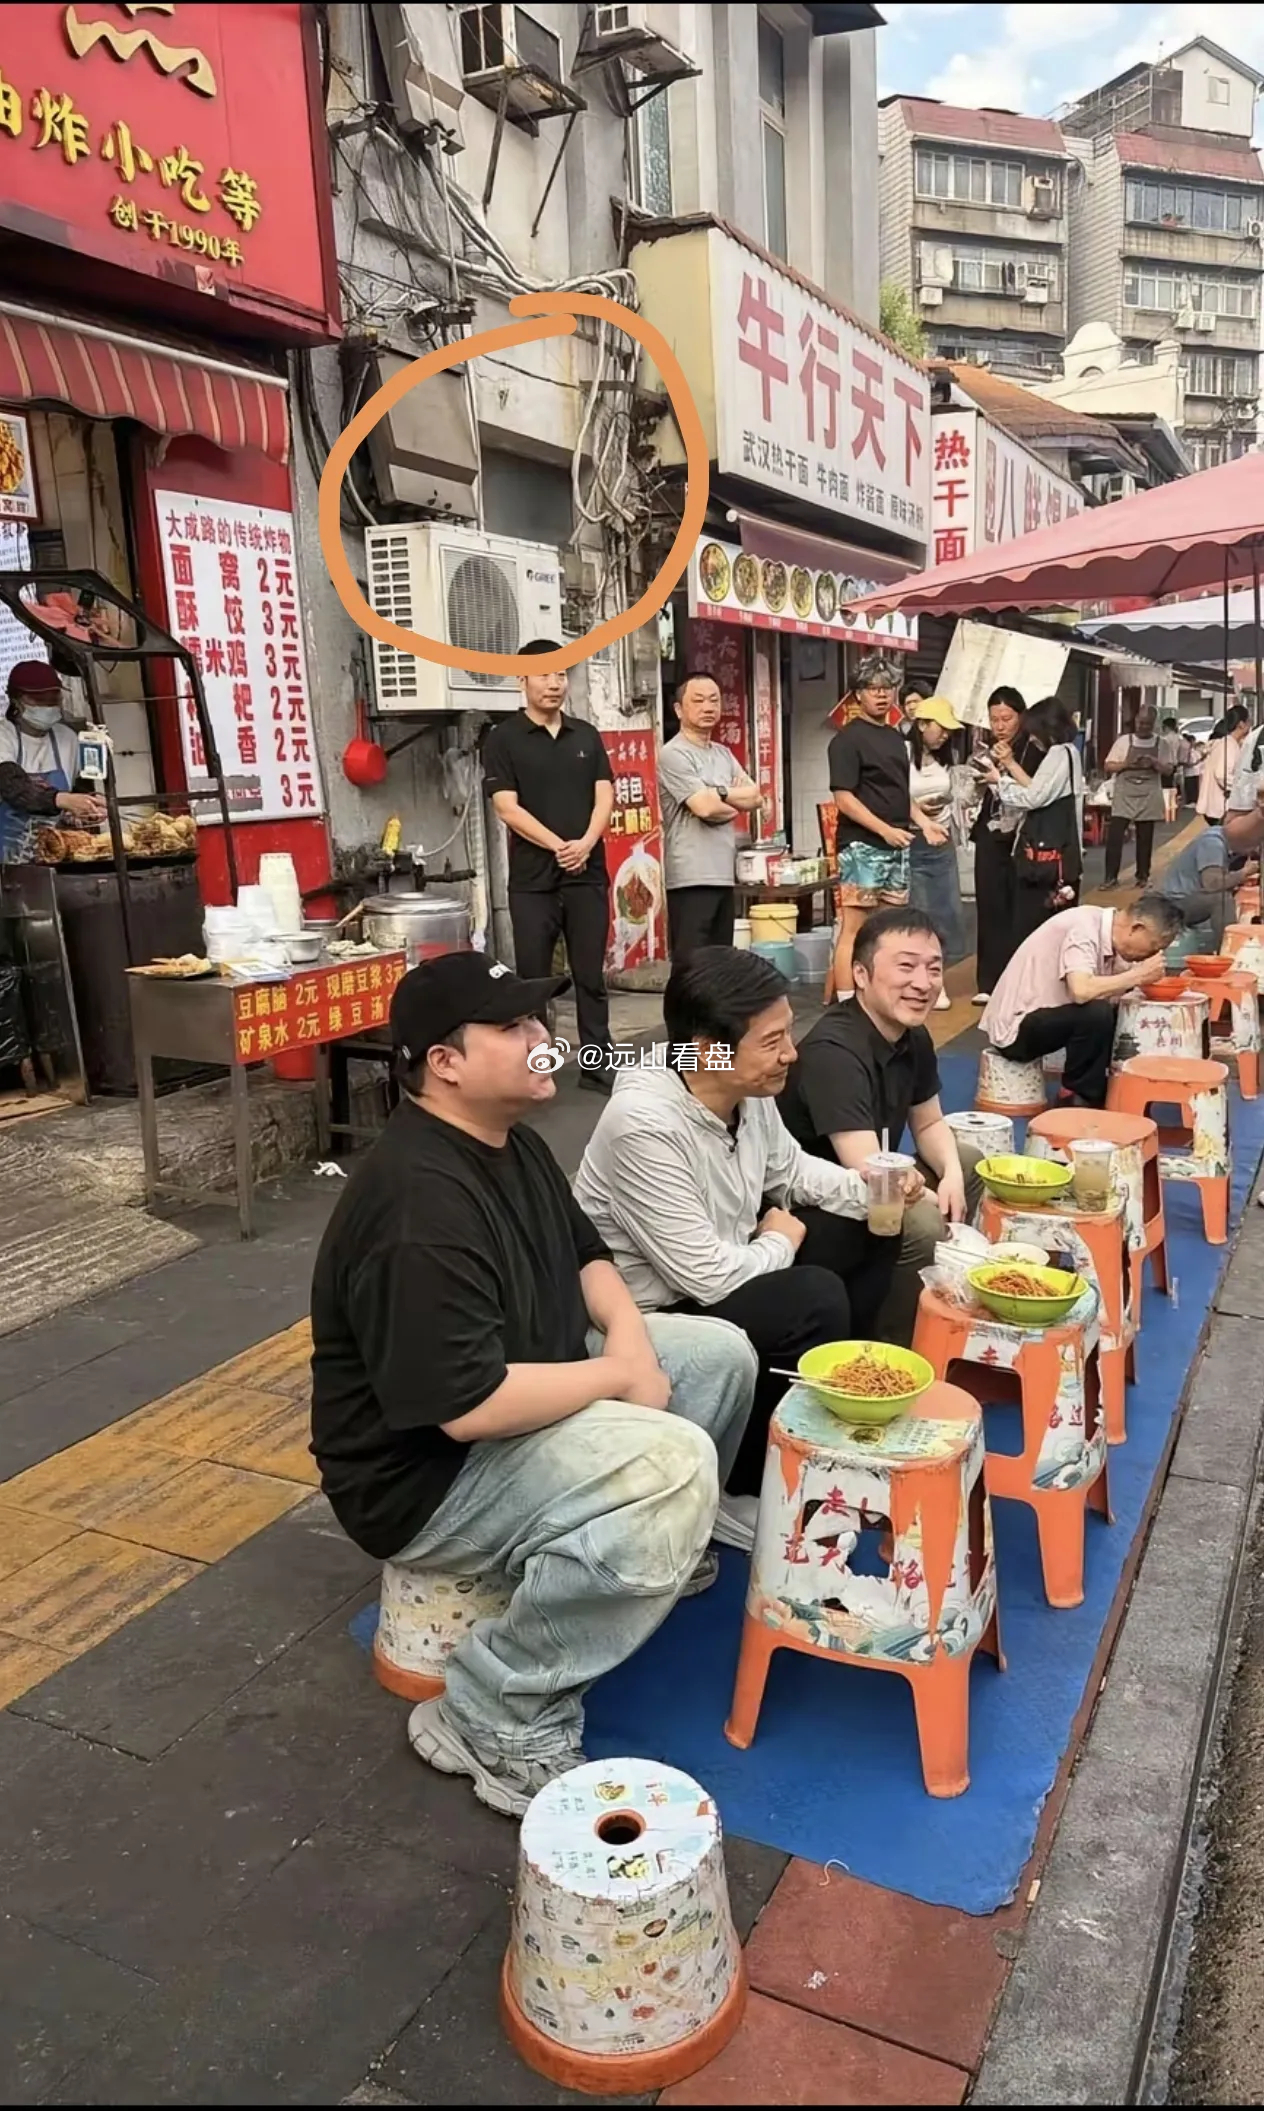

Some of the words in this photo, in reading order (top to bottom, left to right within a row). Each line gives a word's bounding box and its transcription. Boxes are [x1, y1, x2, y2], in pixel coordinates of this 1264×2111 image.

[738, 271, 924, 487] 牛行天下
[743, 430, 808, 487] 武汉热干面
[817, 463, 849, 502] 牛肉面
[934, 430, 970, 566] 热干面
[166, 509, 292, 555] 大成路的传统炸物
[239, 985, 288, 1021] 豆腐脑
[295, 978, 319, 1006] 2元
[326, 963, 382, 999] 现磨豆浆
[239, 1018, 289, 1055] 矿泉水
[297, 1012, 320, 1039] 2元
